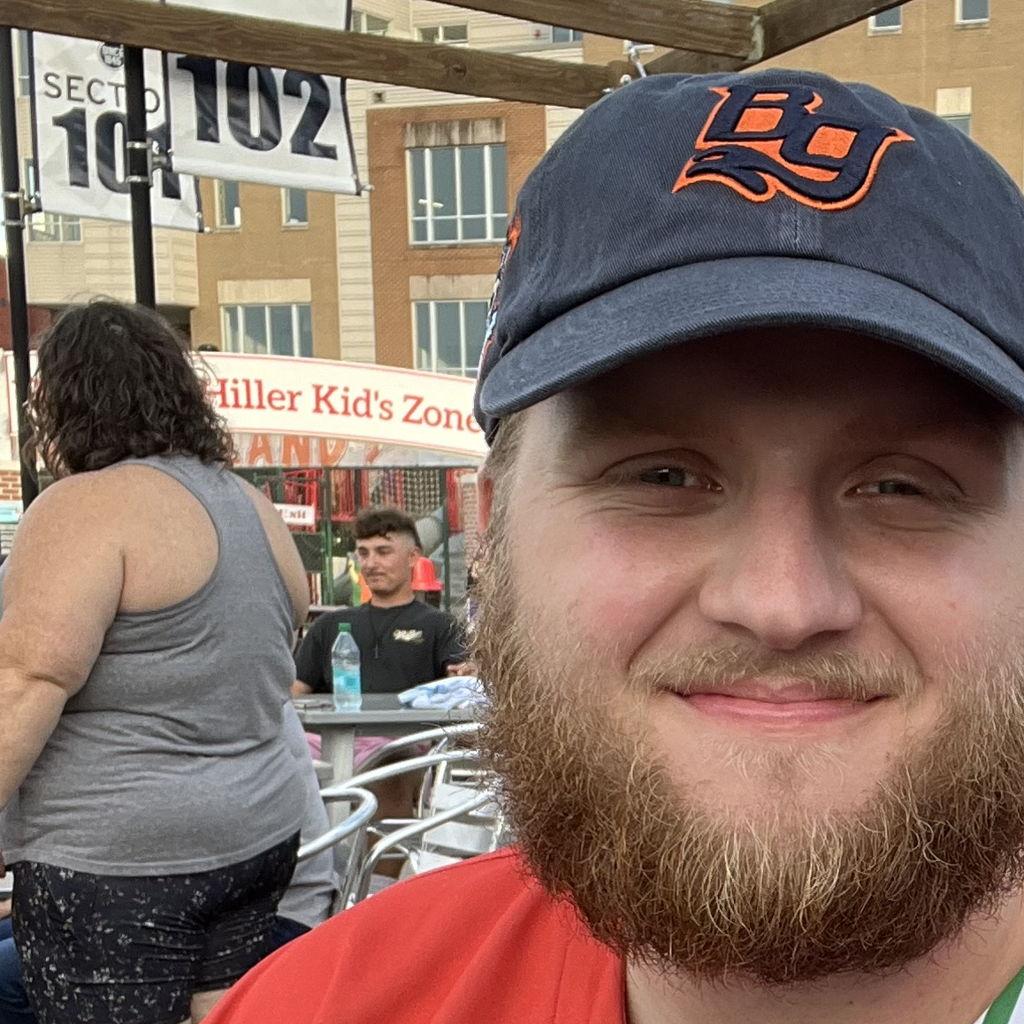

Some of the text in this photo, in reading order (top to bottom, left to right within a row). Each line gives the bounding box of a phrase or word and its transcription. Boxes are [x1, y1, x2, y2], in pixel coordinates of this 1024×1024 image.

[177, 55, 337, 160] 102
[206, 378, 481, 433] Hiller Kid's Zone
